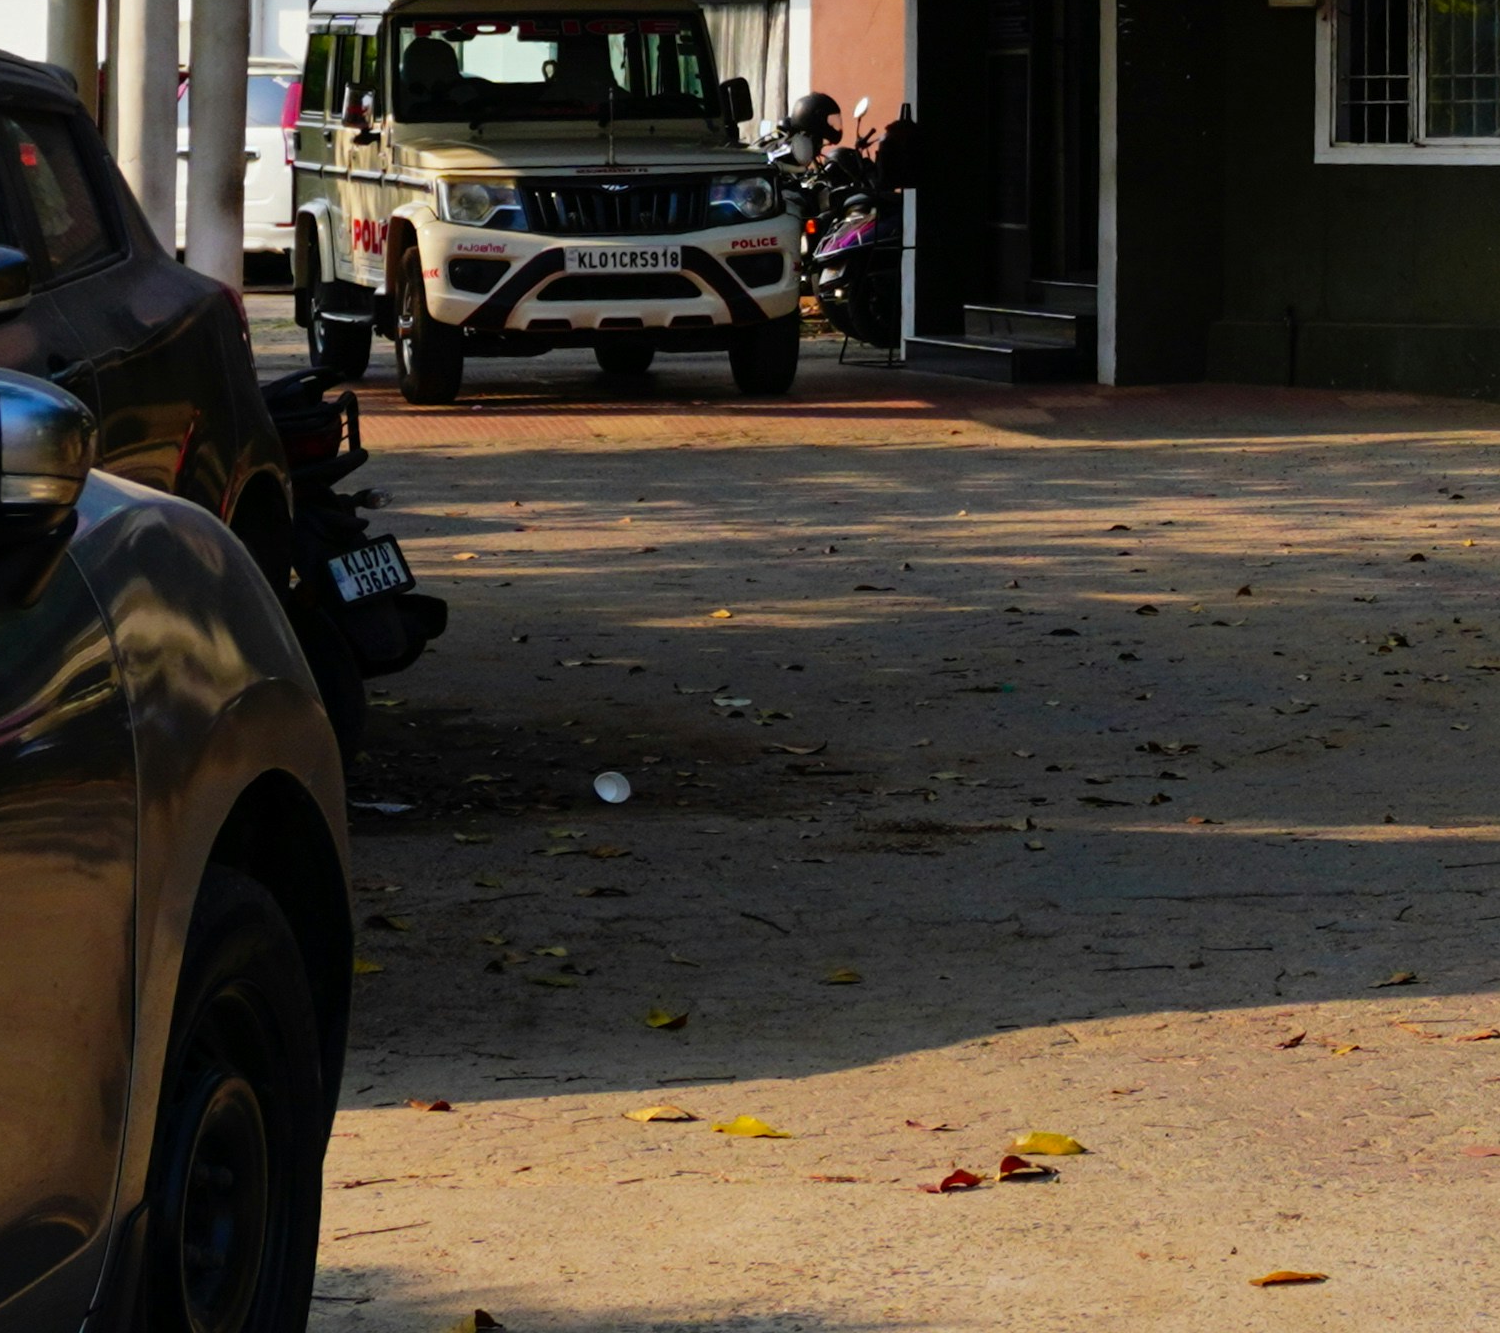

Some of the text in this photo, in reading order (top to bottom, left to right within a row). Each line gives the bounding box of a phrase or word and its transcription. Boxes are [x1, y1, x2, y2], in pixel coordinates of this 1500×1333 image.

[413, 19, 681, 37] POLICE
[731, 236, 778, 249] POLICE
[577, 250, 680, 269] KL01CR5918
[355, 565, 401, 596] J3643
